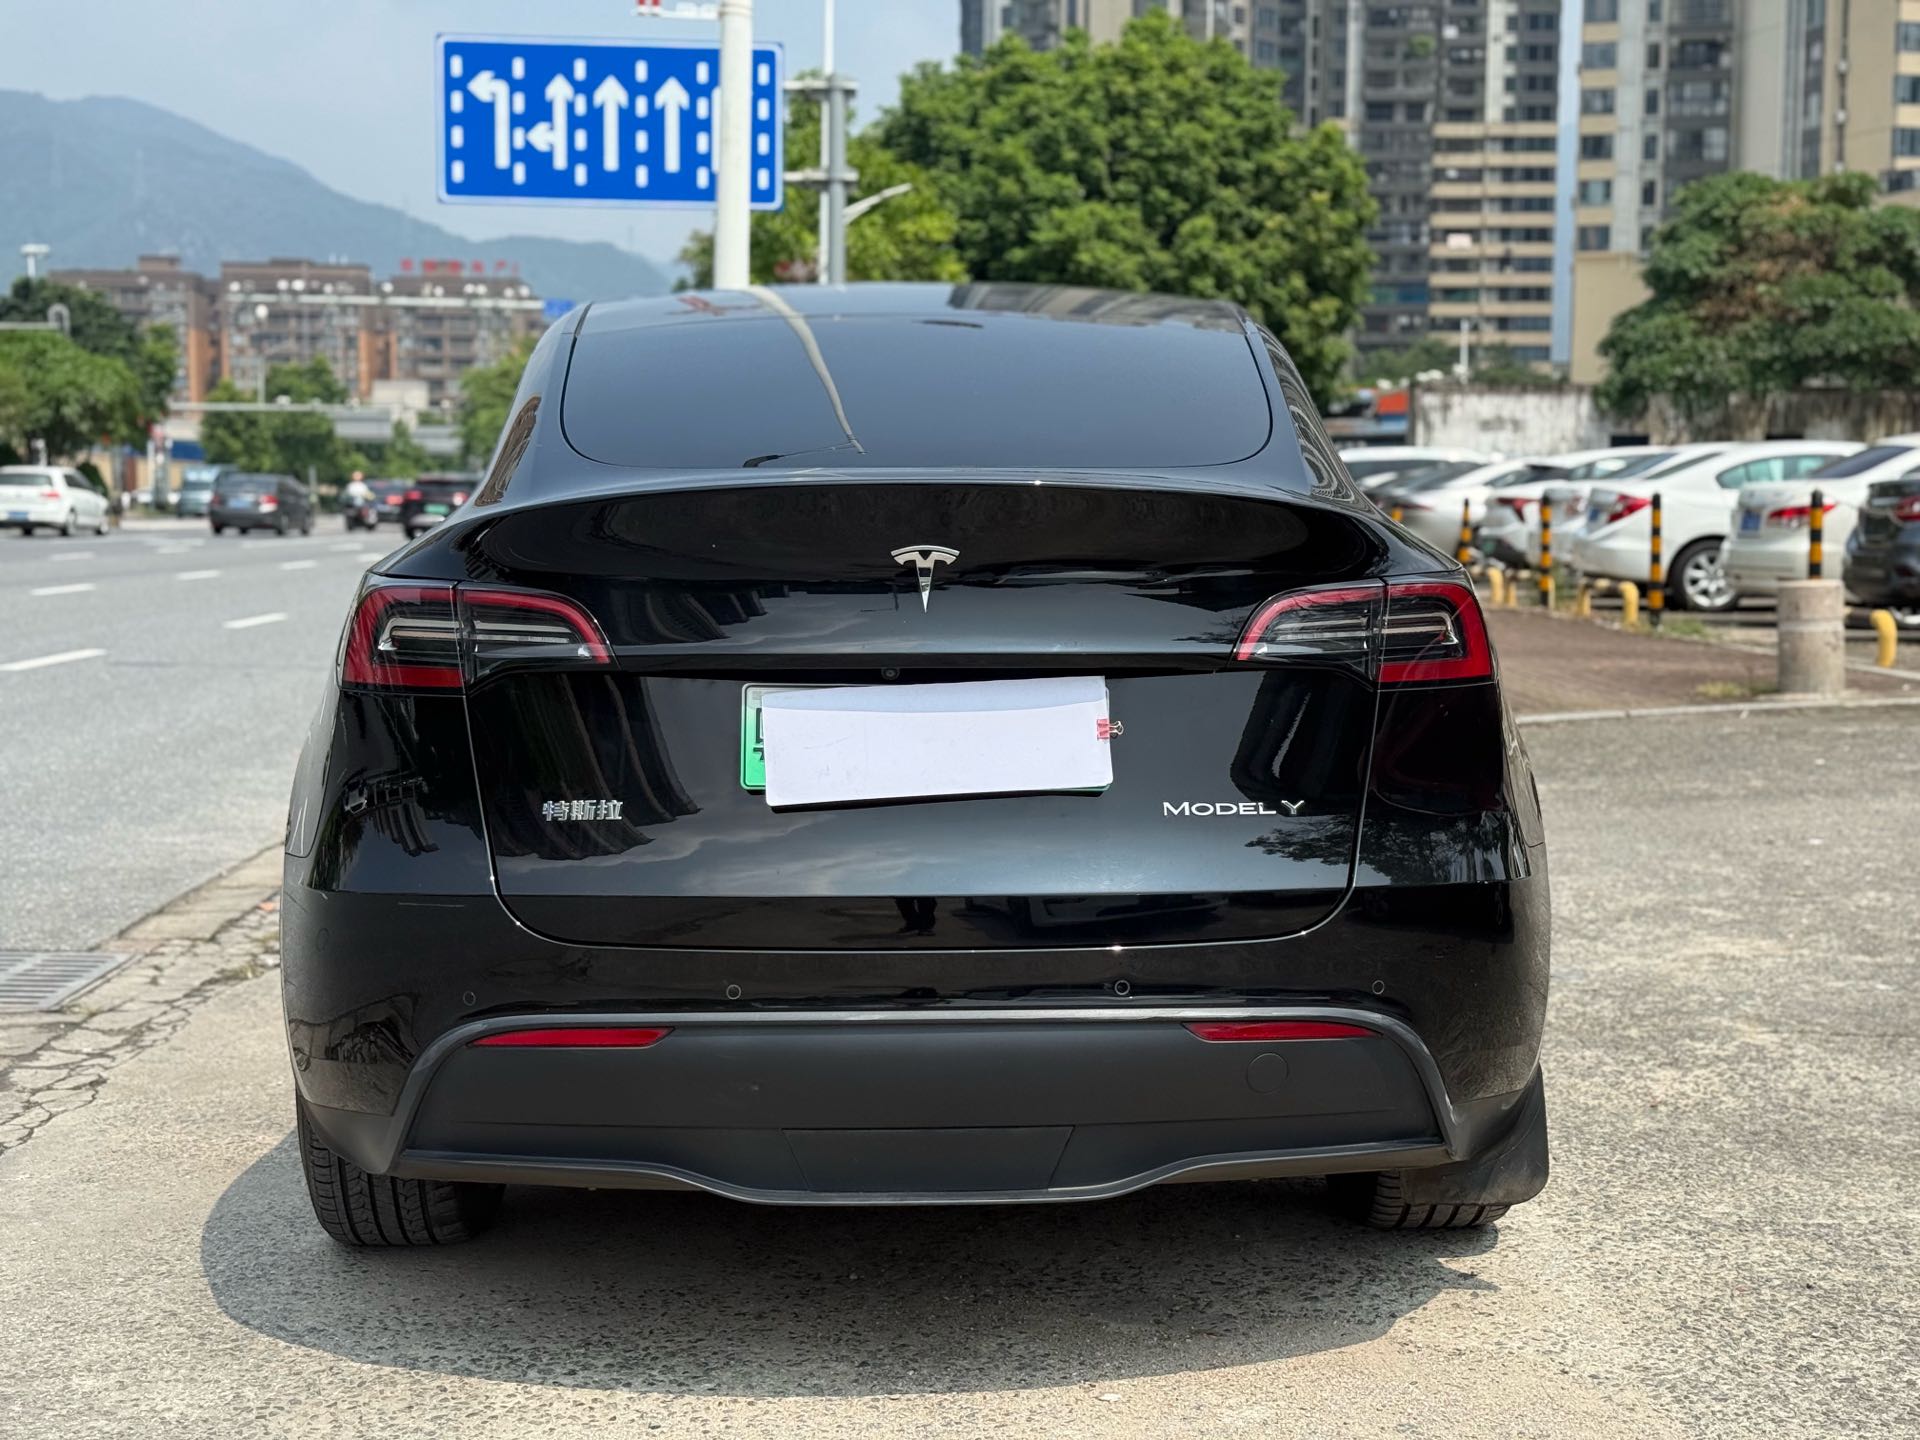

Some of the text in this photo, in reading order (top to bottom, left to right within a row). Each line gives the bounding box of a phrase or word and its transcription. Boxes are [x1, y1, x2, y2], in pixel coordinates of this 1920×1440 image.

[542, 800, 623, 821] 特斯拉
[1163, 800, 1304, 816] MODEL Y
